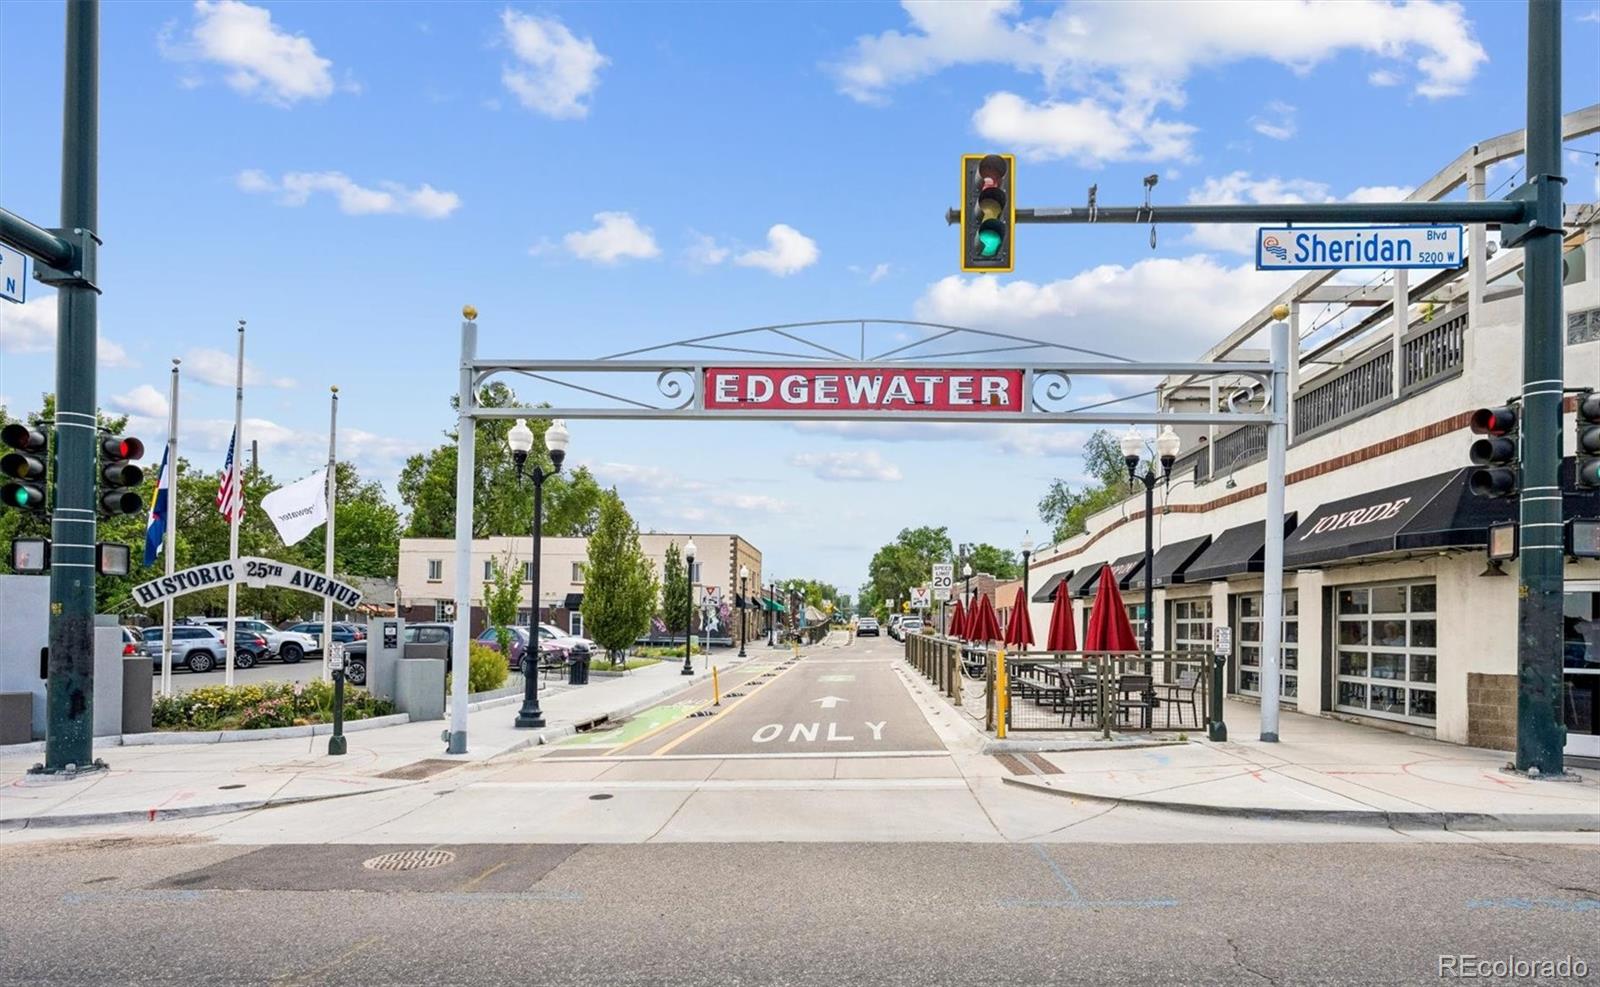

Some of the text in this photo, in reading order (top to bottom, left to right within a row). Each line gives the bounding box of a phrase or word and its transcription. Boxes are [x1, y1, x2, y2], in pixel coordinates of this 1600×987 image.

[1427, 230, 1447, 241] Blvd
[1295, 233, 1412, 263] Sheridan
[1418, 252, 1455, 263] 5200 W
[7, 277, 16, 294] N
[716, 374, 1010, 405] EDGEWATER
[1300, 497, 1412, 541] JOYRIDE
[136, 561, 361, 609] HISTORIC 25TH AVENUE
[934, 577, 952, 587] 20
[752, 721, 887, 743] ONLY
